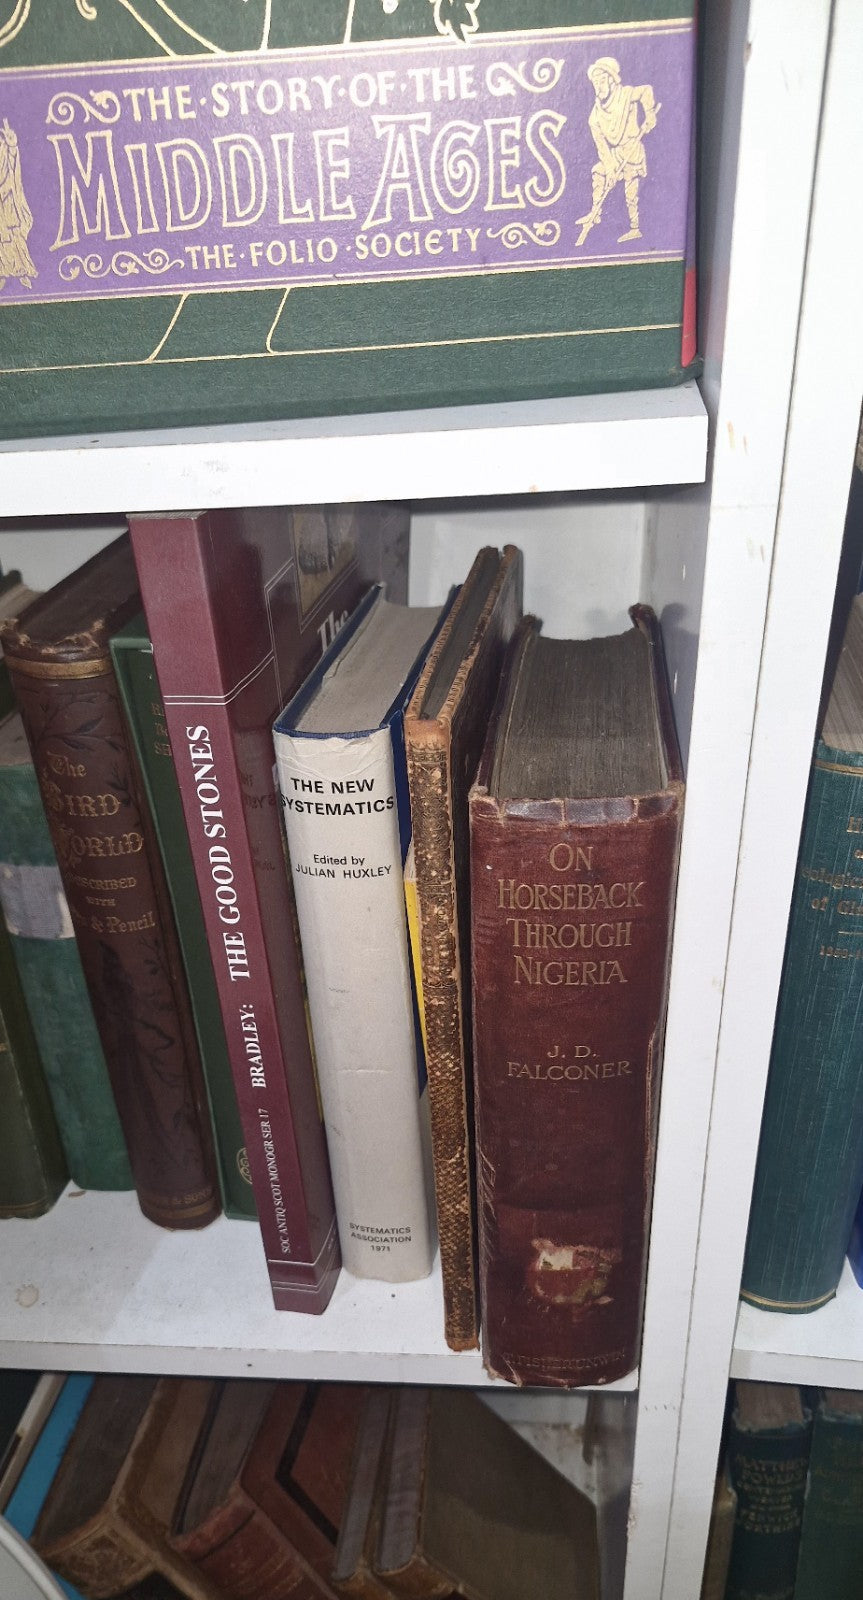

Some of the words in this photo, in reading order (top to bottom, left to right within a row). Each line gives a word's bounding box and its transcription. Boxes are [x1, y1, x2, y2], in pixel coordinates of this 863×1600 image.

[48, 128, 357, 252] MIDDLE
[362, 109, 567, 230] AGES
[186, 724, 227, 839] STONES
[290, 777, 325, 794] THE
[332, 778, 375, 794] NEW
[280, 794, 395, 816] SYSTEMATICS
[313, 854, 348, 866] Edited
[351, 856, 366, 867] by
[550, 843, 594, 872] ON
[65, 872, 137, 891] SCRIBED
[296, 864, 336, 878] JULIAN
[343, 865, 392, 879] HUXLEY
[208, 845, 241, 925] GOOD
[498, 879, 647, 910] HORSEBACK
[105, 911, 156, 933] Pencil
[506, 918, 633, 949] THROUGH
[223, 932, 251, 982] THE
[514, 955, 628, 986] NIGERIA
[239, 1003, 267, 1089] BRADLEY:
[547, 1045, 566, 1059] J.
[574, 1045, 598, 1058] D.
[507, 1060, 633, 1081] FALCONER
[258, 1108, 269, 1118] 17
[260, 1120, 273, 1139] SER
[264, 1140, 280, 1182] MONOGR
[270, 1182, 284, 1206] SCOT
[275, 1207, 289, 1235] ANTIQ
[349, 1222, 411, 1235] SYSTEMATICS
[280, 1235, 291, 1254] SOC
[350, 1232, 412, 1243] ASSOCIATION
